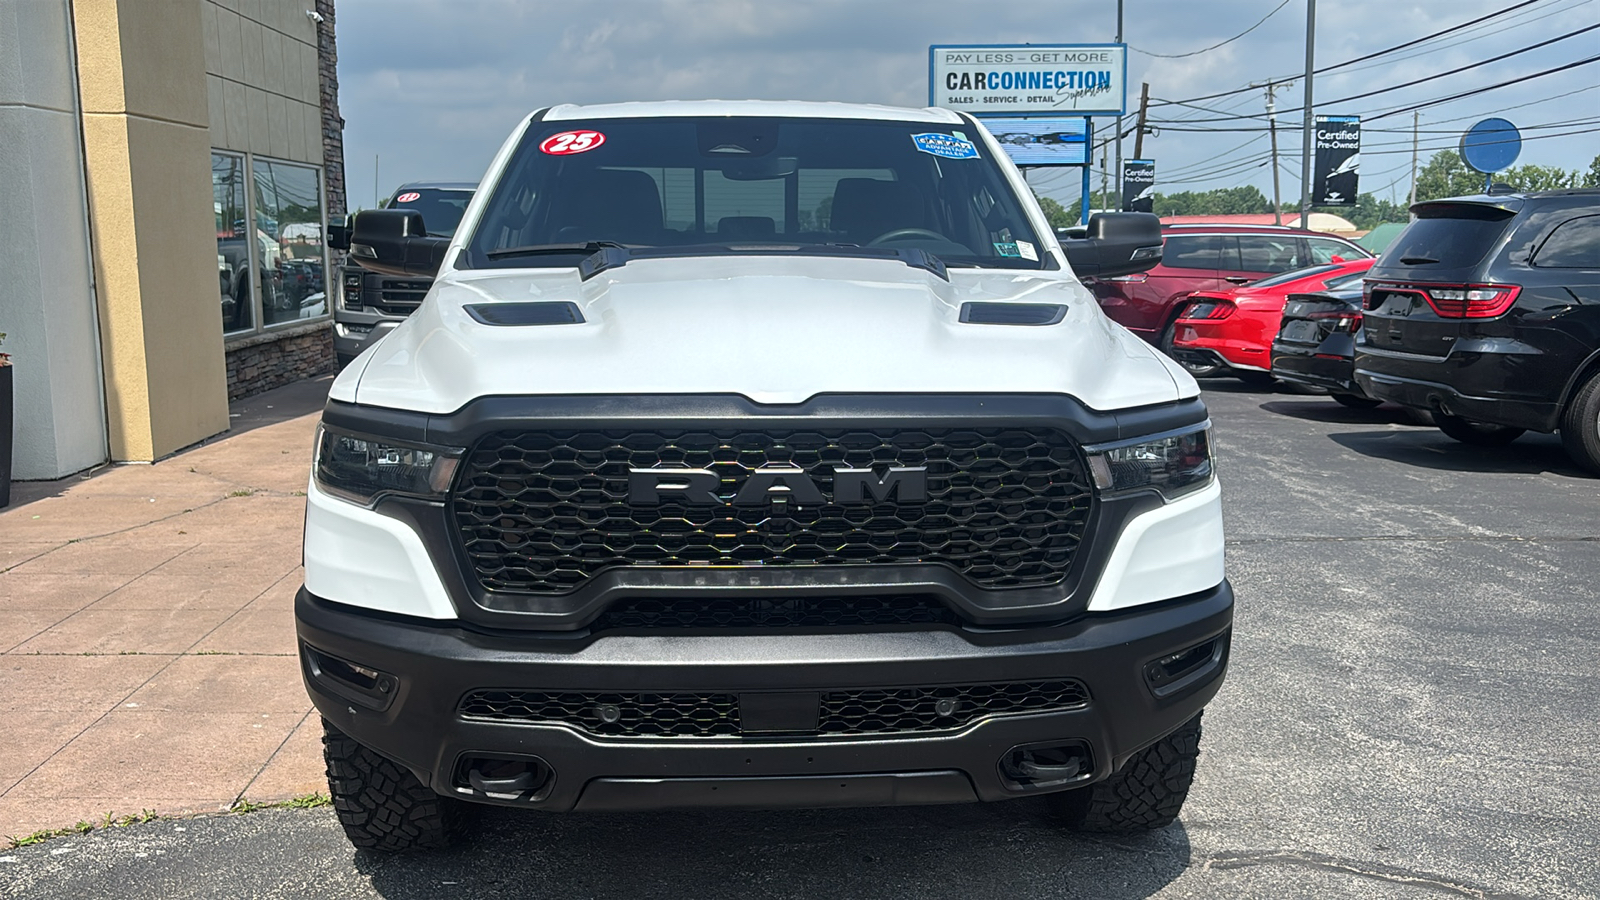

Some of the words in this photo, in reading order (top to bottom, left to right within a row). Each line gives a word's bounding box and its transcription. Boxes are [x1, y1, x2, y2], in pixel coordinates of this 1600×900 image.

[946, 54, 973, 63] PAY
[976, 54, 1014, 63] LESS
[1030, 53, 1060, 62] GET
[1064, 53, 1113, 62] MORE.
[948, 96, 974, 104] SALES
[983, 95, 1018, 103] SERVICE
[1026, 95, 1056, 103] DETAIL
[1052, 80, 1113, 109] Superstore
[1317, 129, 1359, 140] Certified
[549, 132, 598, 152] 25
[1317, 140, 1359, 149] Pre-Owned
[925, 144, 970, 154] ADVANTAGE
[934, 149, 965, 157] DEALER
[1125, 168, 1154, 177] Certified
[628, 467, 927, 506] RAM
